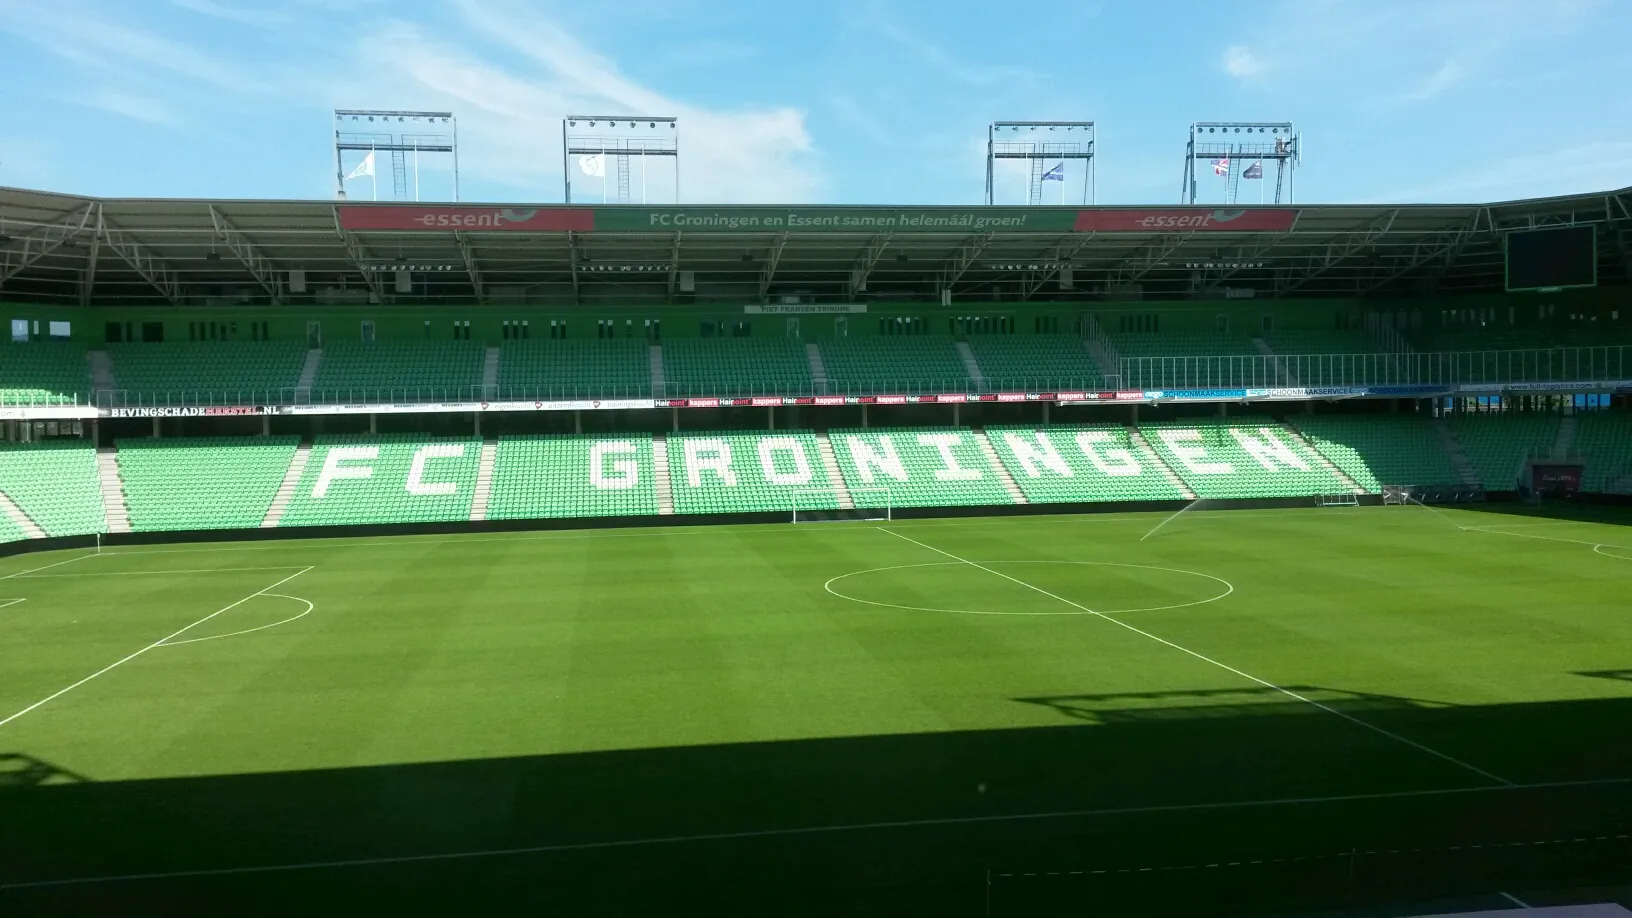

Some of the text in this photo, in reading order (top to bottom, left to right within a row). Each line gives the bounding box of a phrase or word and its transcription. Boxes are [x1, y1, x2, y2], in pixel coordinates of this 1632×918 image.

[415, 212, 506, 226] essent
[650, 213, 1027, 228] FC Groningen en Essent samen helemáál groen!
[1136, 213, 1214, 227] essent
[1163, 388, 1247, 398] SCHOONMAAKSERVICE
[1267, 388, 1348, 397] SCHOONMAAKSERVICE
[312, 426, 1311, 498] FC GRONINGEN
